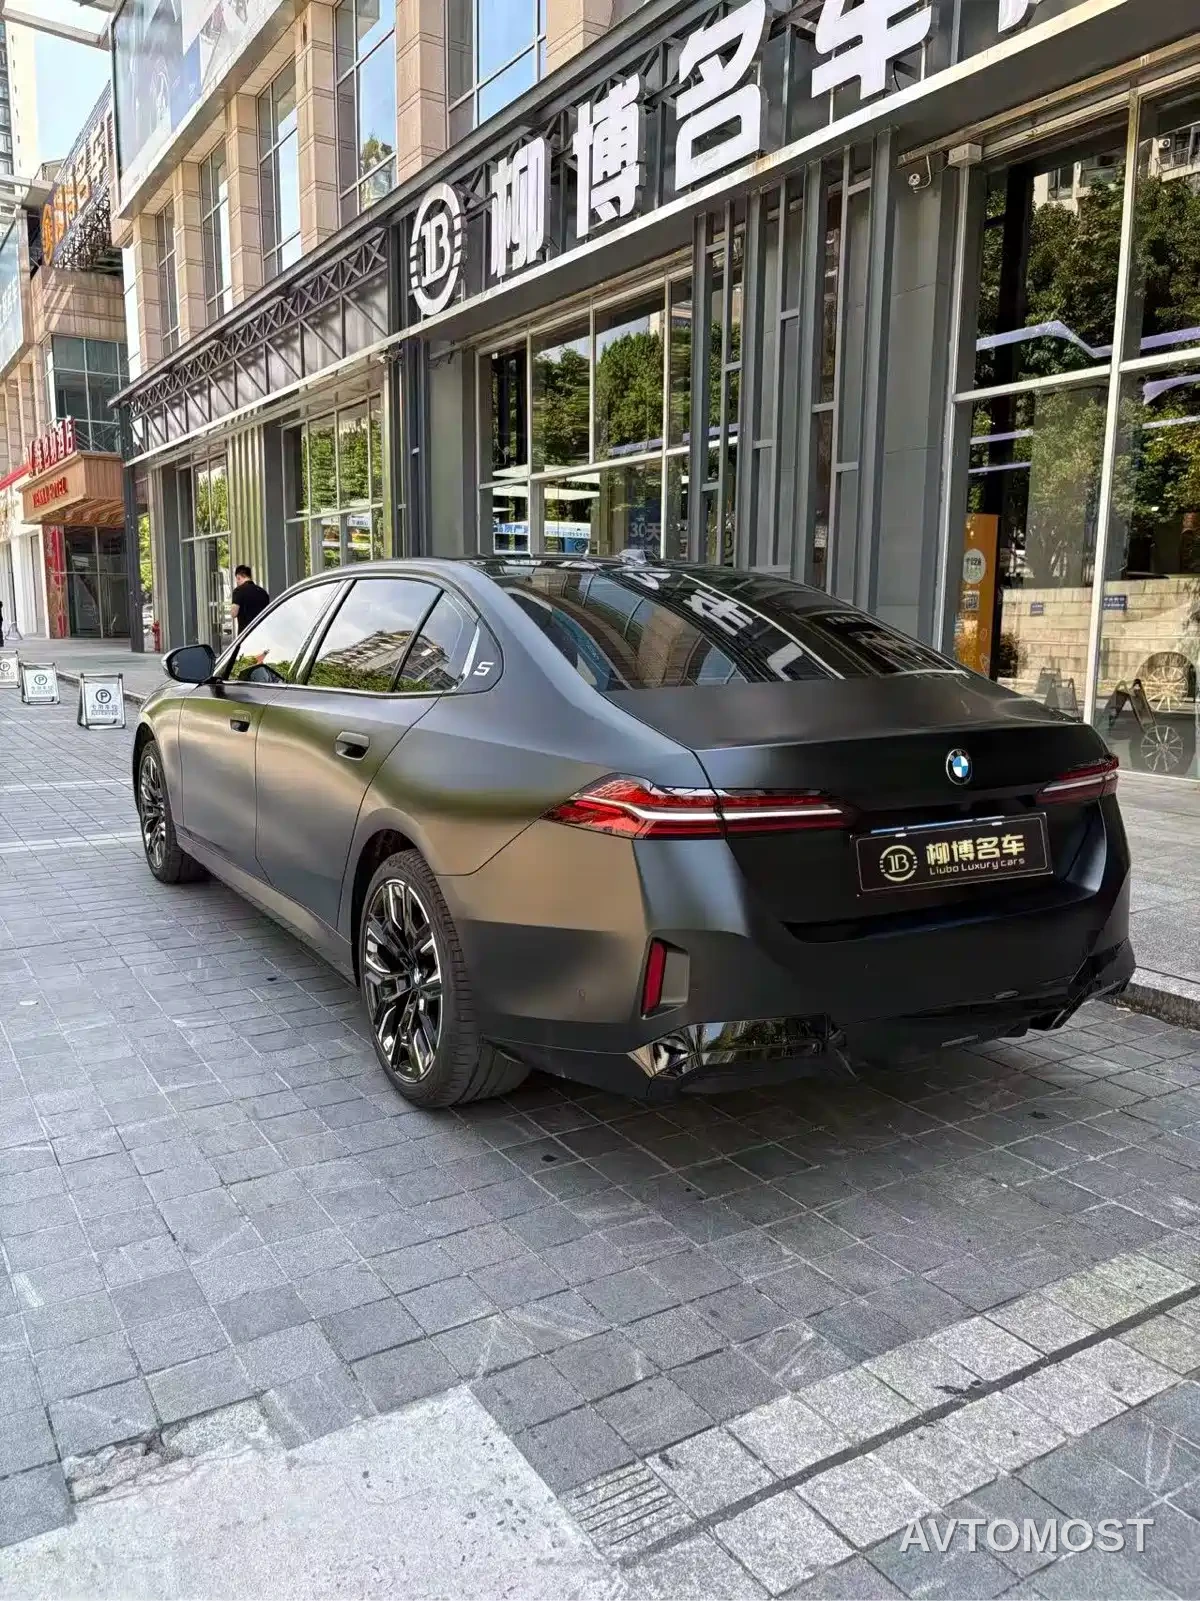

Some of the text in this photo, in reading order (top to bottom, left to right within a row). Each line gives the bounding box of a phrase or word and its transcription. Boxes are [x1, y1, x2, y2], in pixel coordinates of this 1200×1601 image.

[490, 0, 1030, 279] 柳博名车
[926, 834, 1026, 866] 柳博名车
[929, 857, 1026, 876] Liubo Luxury cars
